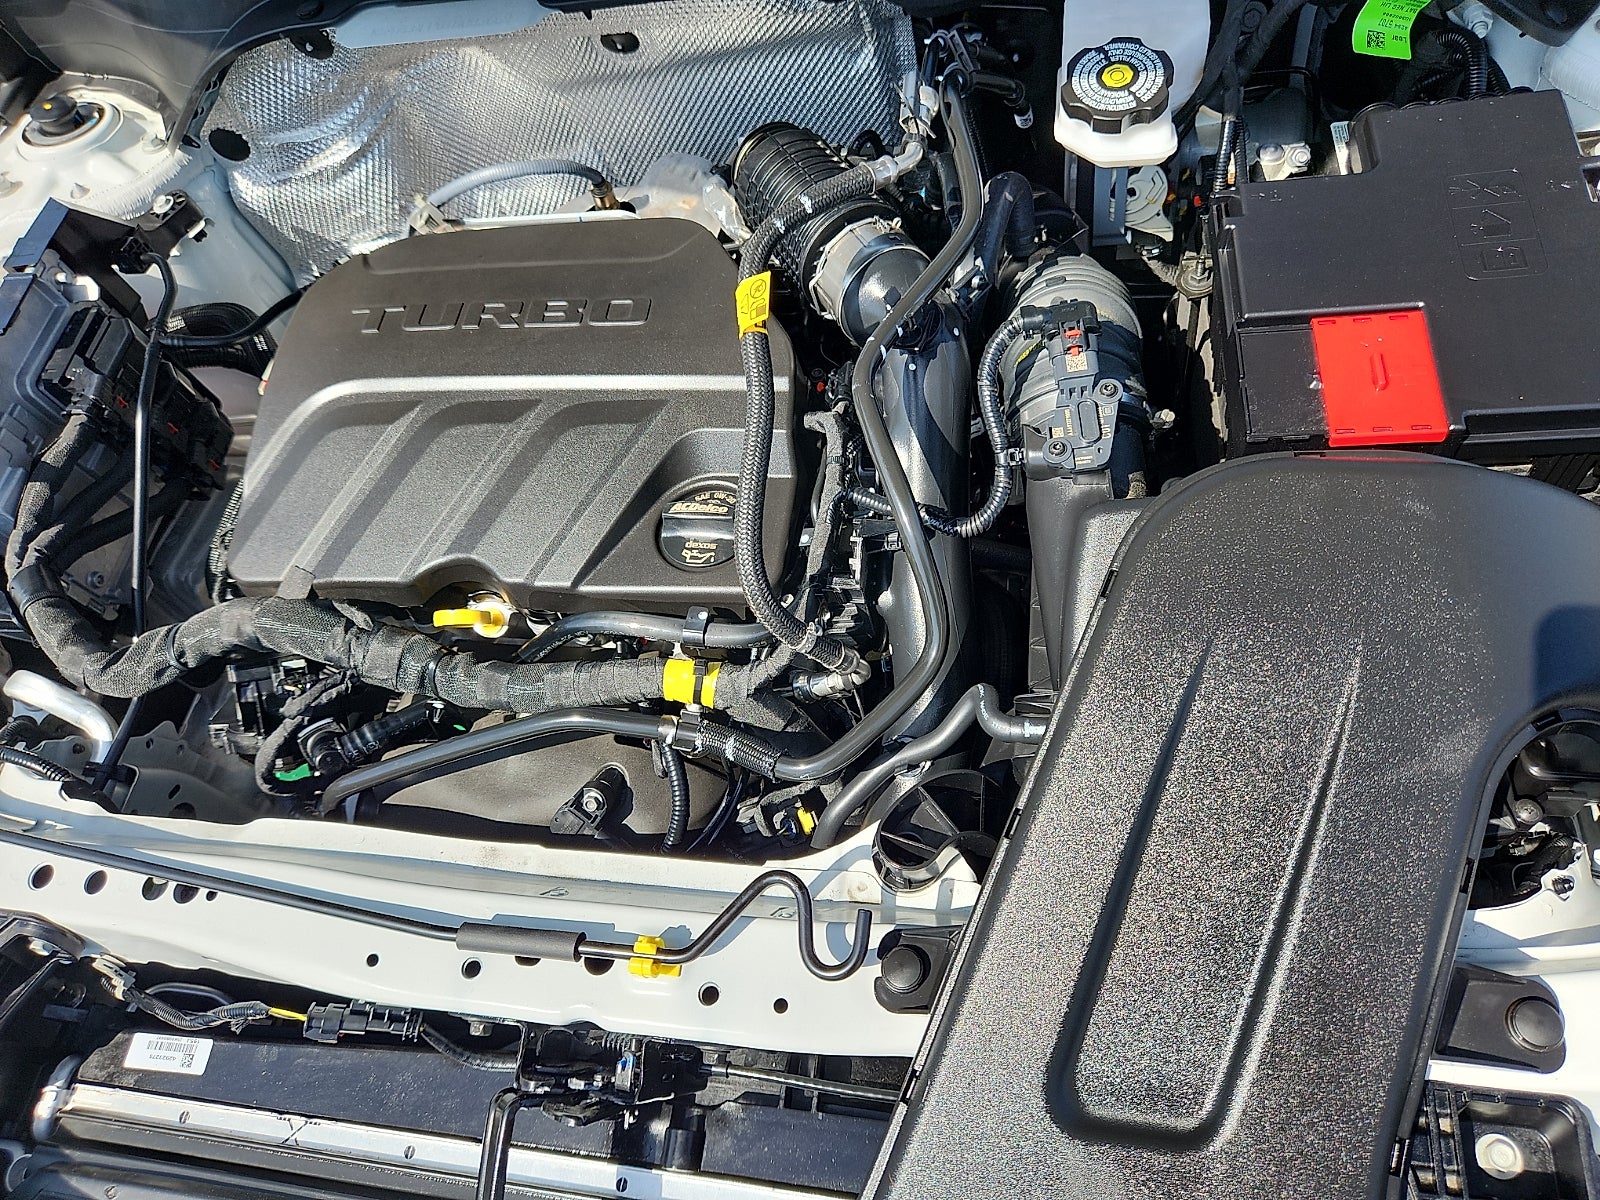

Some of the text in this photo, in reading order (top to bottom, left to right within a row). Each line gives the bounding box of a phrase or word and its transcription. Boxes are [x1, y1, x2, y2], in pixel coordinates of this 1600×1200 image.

[1138, 46, 1158, 60] SEALED
[351, 298, 652, 334] TURBO
[694, 493, 711, 501] SAE
[669, 502, 729, 513] ACDelco
[685, 539, 719, 549] dexos
